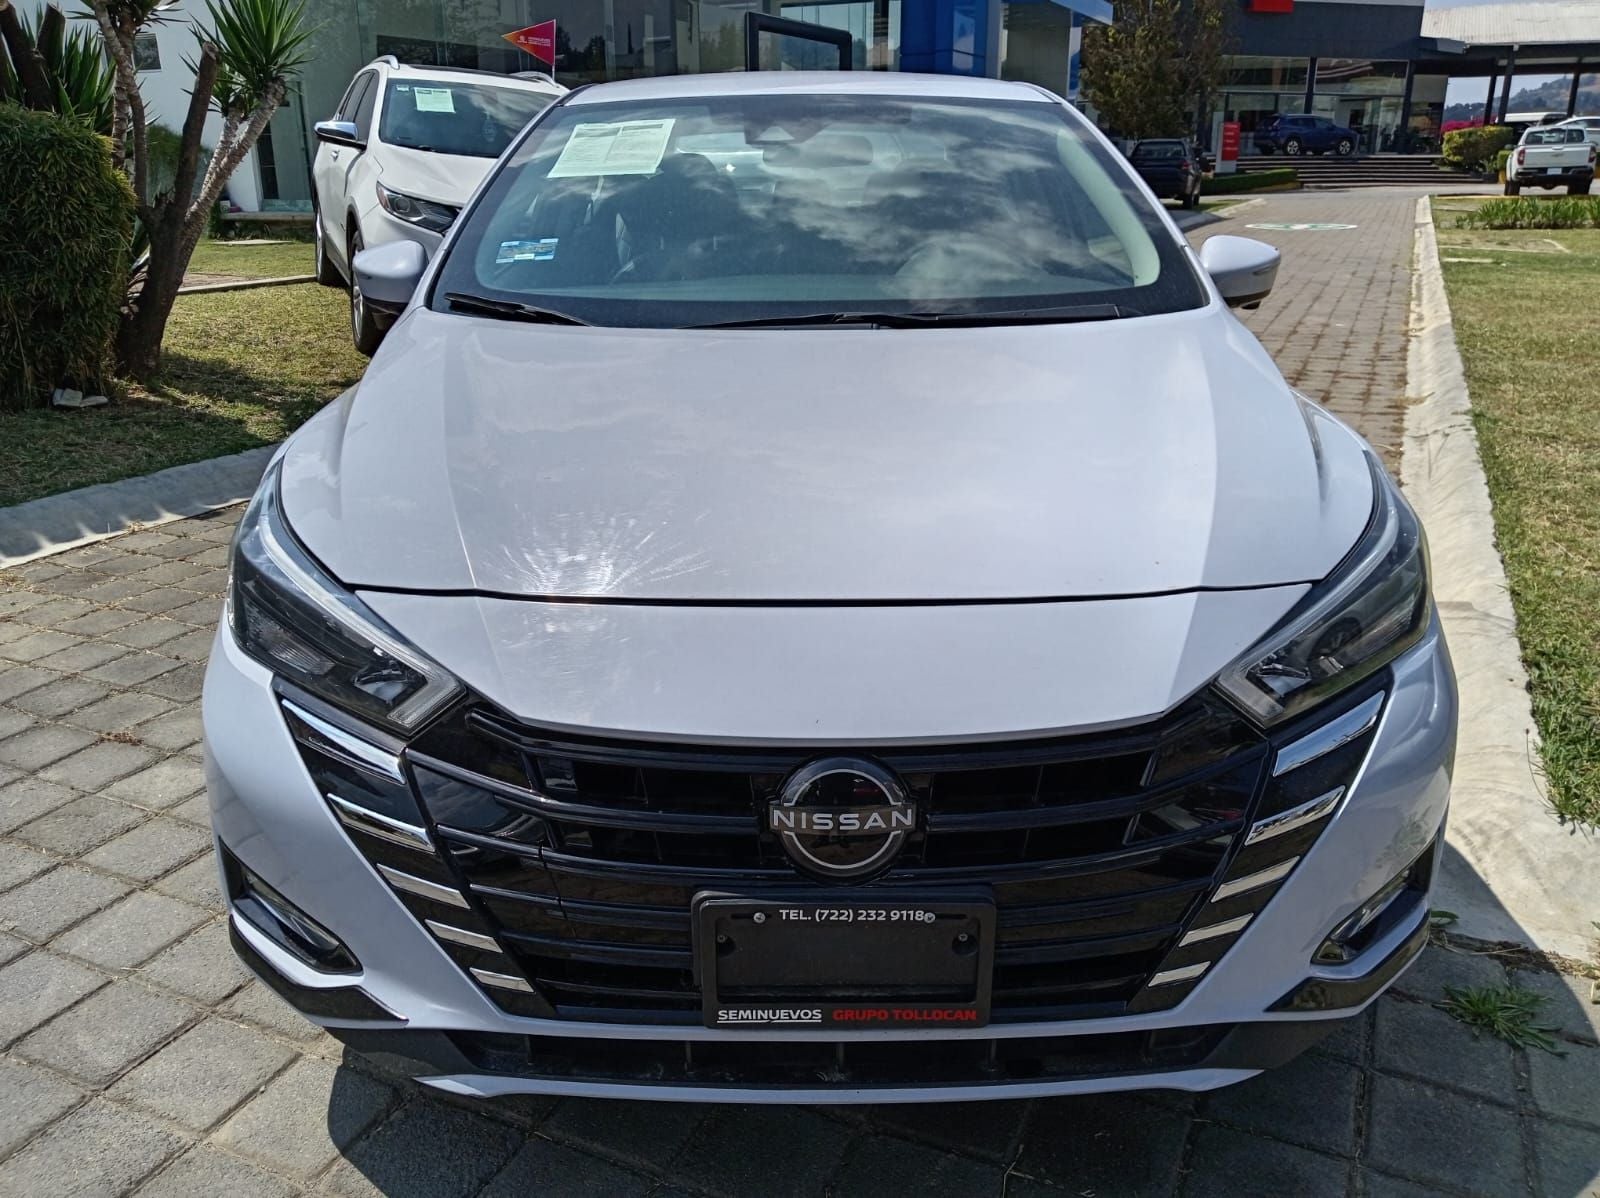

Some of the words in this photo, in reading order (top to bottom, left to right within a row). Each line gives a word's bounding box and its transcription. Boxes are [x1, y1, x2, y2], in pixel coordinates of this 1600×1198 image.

[773, 808, 912, 831] NISSAN
[779, 909, 811, 921] TEL.
[815, 908, 853, 923] (722)
[857, 909, 886, 921] 232
[891, 909, 924, 921] 9118
[717, 1008, 822, 1022] SEMINUEVOS
[832, 1009, 888, 1021] GRUPO
[894, 1009, 977, 1021] TOLLOCAN
